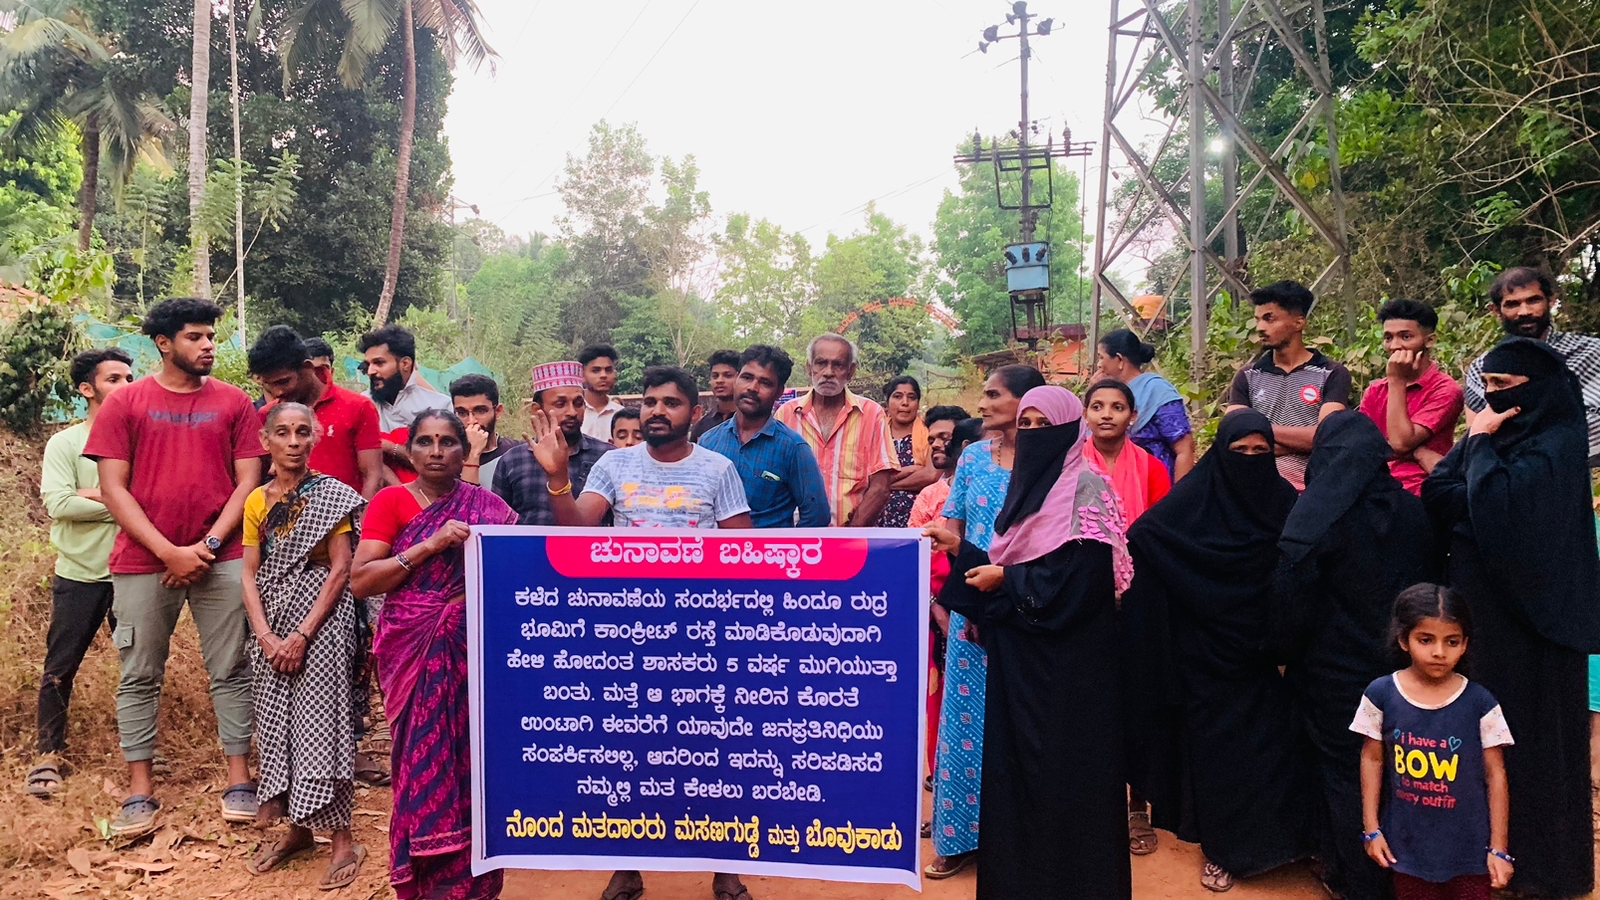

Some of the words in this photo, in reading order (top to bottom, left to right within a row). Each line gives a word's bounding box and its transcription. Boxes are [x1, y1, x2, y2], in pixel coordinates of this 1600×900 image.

[720, 537, 824, 578] ಬಹಿಷ್ಕಾರ
[515, 587, 558, 606] ಕಳೆದ
[568, 588, 665, 607] ಚುನಾವಣೆಯ
[675, 589, 773, 616] ಸಂದರ್ಭದಲ್ಲಿ
[783, 590, 841, 609] ಹಿಂದೂ
[851, 591, 887, 617] ರುದ್ರ
[521, 619, 585, 640] ಭೂಮಿಗೆ
[595, 621, 677, 645] ಕಾಂಕ್ರೀಟ್
[687, 622, 715, 646] ರಸ್ತೆ
[725, 622, 881, 646] ಮಾಡಿಕೊಡುವುದಾಗಿ
[554, 651, 633, 670] ಹೋದಂತ
[643, 654, 717, 671] ಶಾಸಕರು
[727, 658, 738, 672] 5
[748, 656, 790, 676] ವರ್ಷ
[799, 656, 897, 682] ಮುಗಿಯುತ್ತಾ
[544, 684, 596, 700] ಬಂತು.
[604, 685, 638, 708] ಮತ್ತೆ
[647, 688, 662, 702] ಆ
[672, 688, 725, 717] ಭಾಗಕ್ಕೆ
[735, 687, 788, 705] ನೀರಿನ
[798, 689, 859, 707] ಕೊರತೆ
[521, 716, 593, 731] ಉಂಟಾಗಿ
[602, 718, 667, 733] ಈವರೆಗೆ
[677, 721, 753, 739] ಯಾವುದೇ
[762, 722, 883, 744] ಜನಪ್ರತಿನಿಧಿಯು
[1408, 732, 1436, 747] have
[1440, 739, 1447, 748] a
[523, 747, 638, 771] ಸಂಪರ್ಕಿಸಲಿಲ್ಲ,
[647, 749, 718, 766] ಆದರಿಂದ
[728, 749, 783, 778] ಇದನ್ನು
[792, 752, 882, 772] ಸರಿಪಡಿಸದೆ
[1394, 744, 1459, 782] BOW
[578, 777, 631, 806] ನಮ್ಮಲ್ಲಿ
[640, 779, 675, 796] ಮತ
[684, 779, 743, 798] ಕೇಳಲು
[752, 782, 825, 802] ಬರಬೇಡಿ.
[1413, 779, 1449, 793] match
[506, 809, 563, 837] ನೊಂದ
[572, 812, 666, 839] ಮತದಾರರು
[675, 812, 760, 858] ಮಸಣಗುಡ್ಡೆ
[768, 824, 799, 852] ಮತ್ತು
